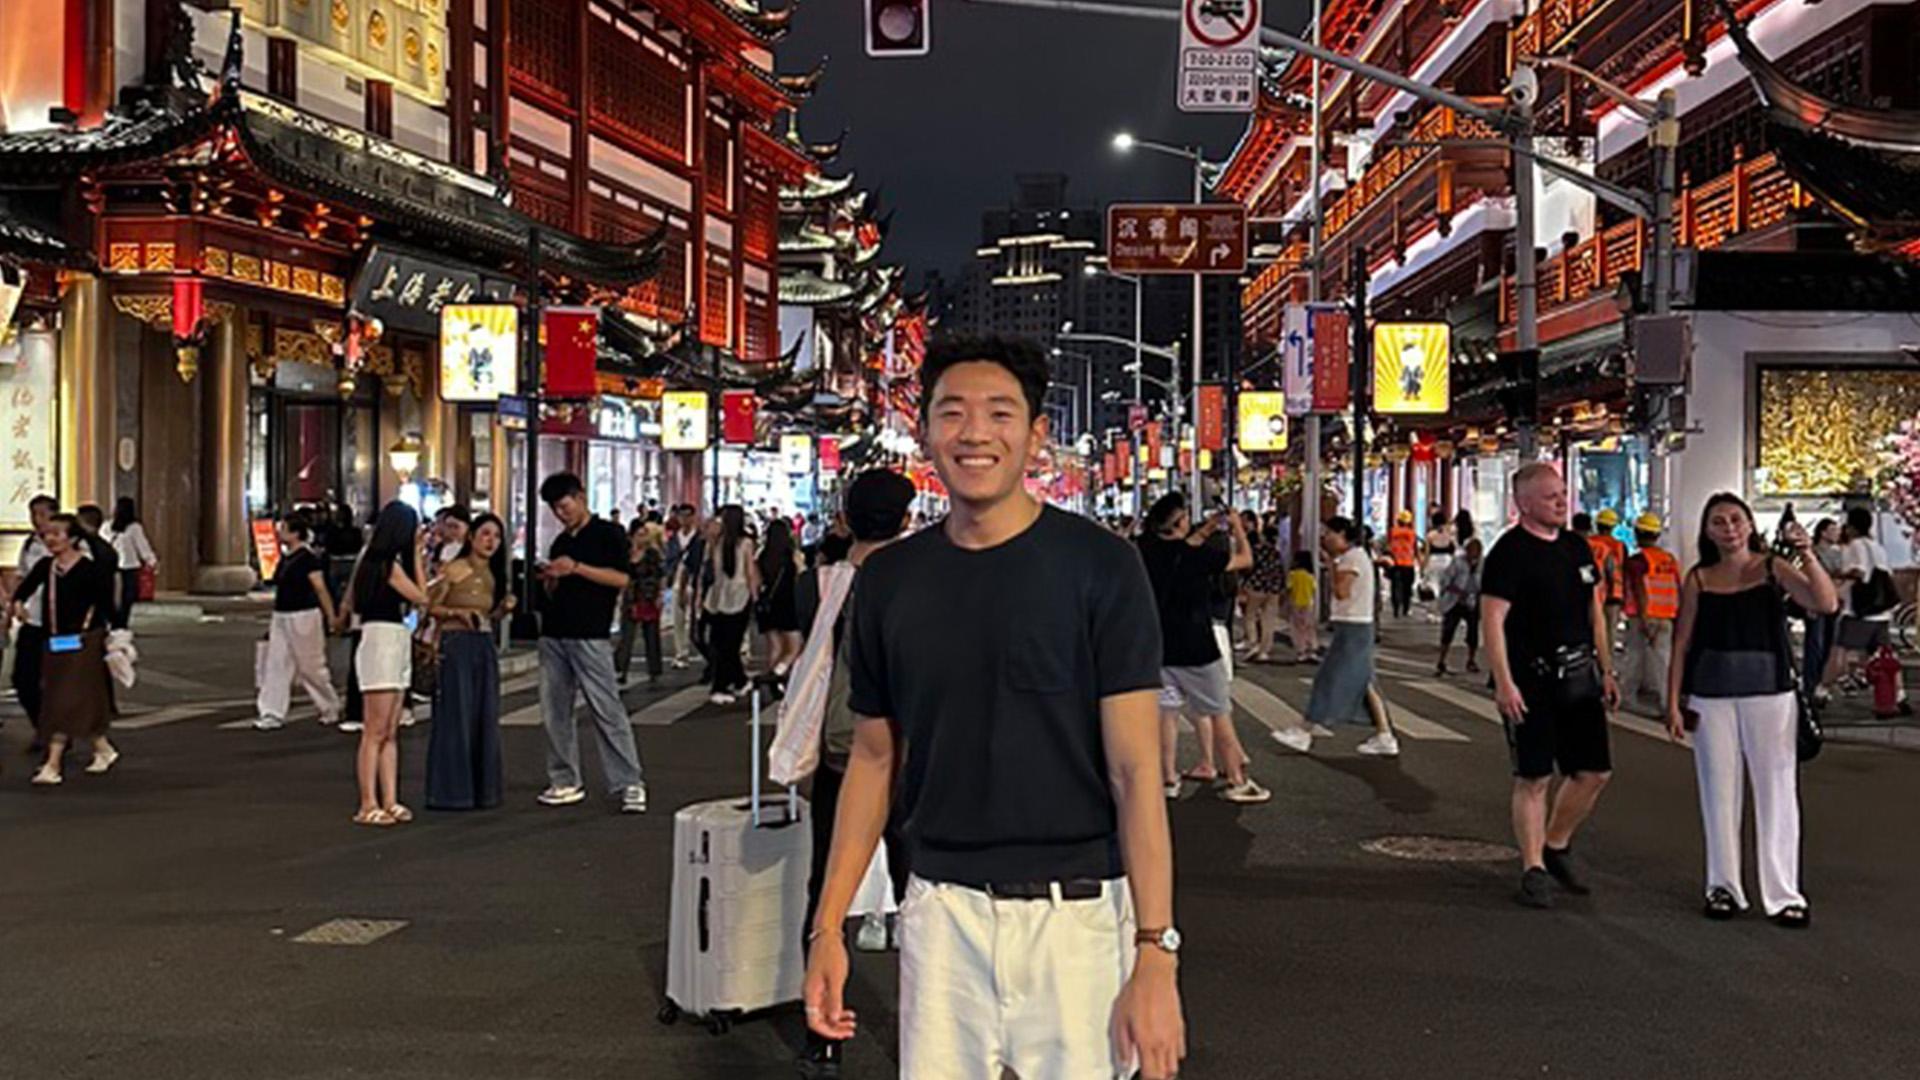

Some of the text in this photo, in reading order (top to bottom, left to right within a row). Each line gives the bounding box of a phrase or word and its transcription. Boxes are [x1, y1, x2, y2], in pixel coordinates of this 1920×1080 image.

[1186, 89, 1250, 102] 大型号牌
[371, 265, 499, 314] 上海老
